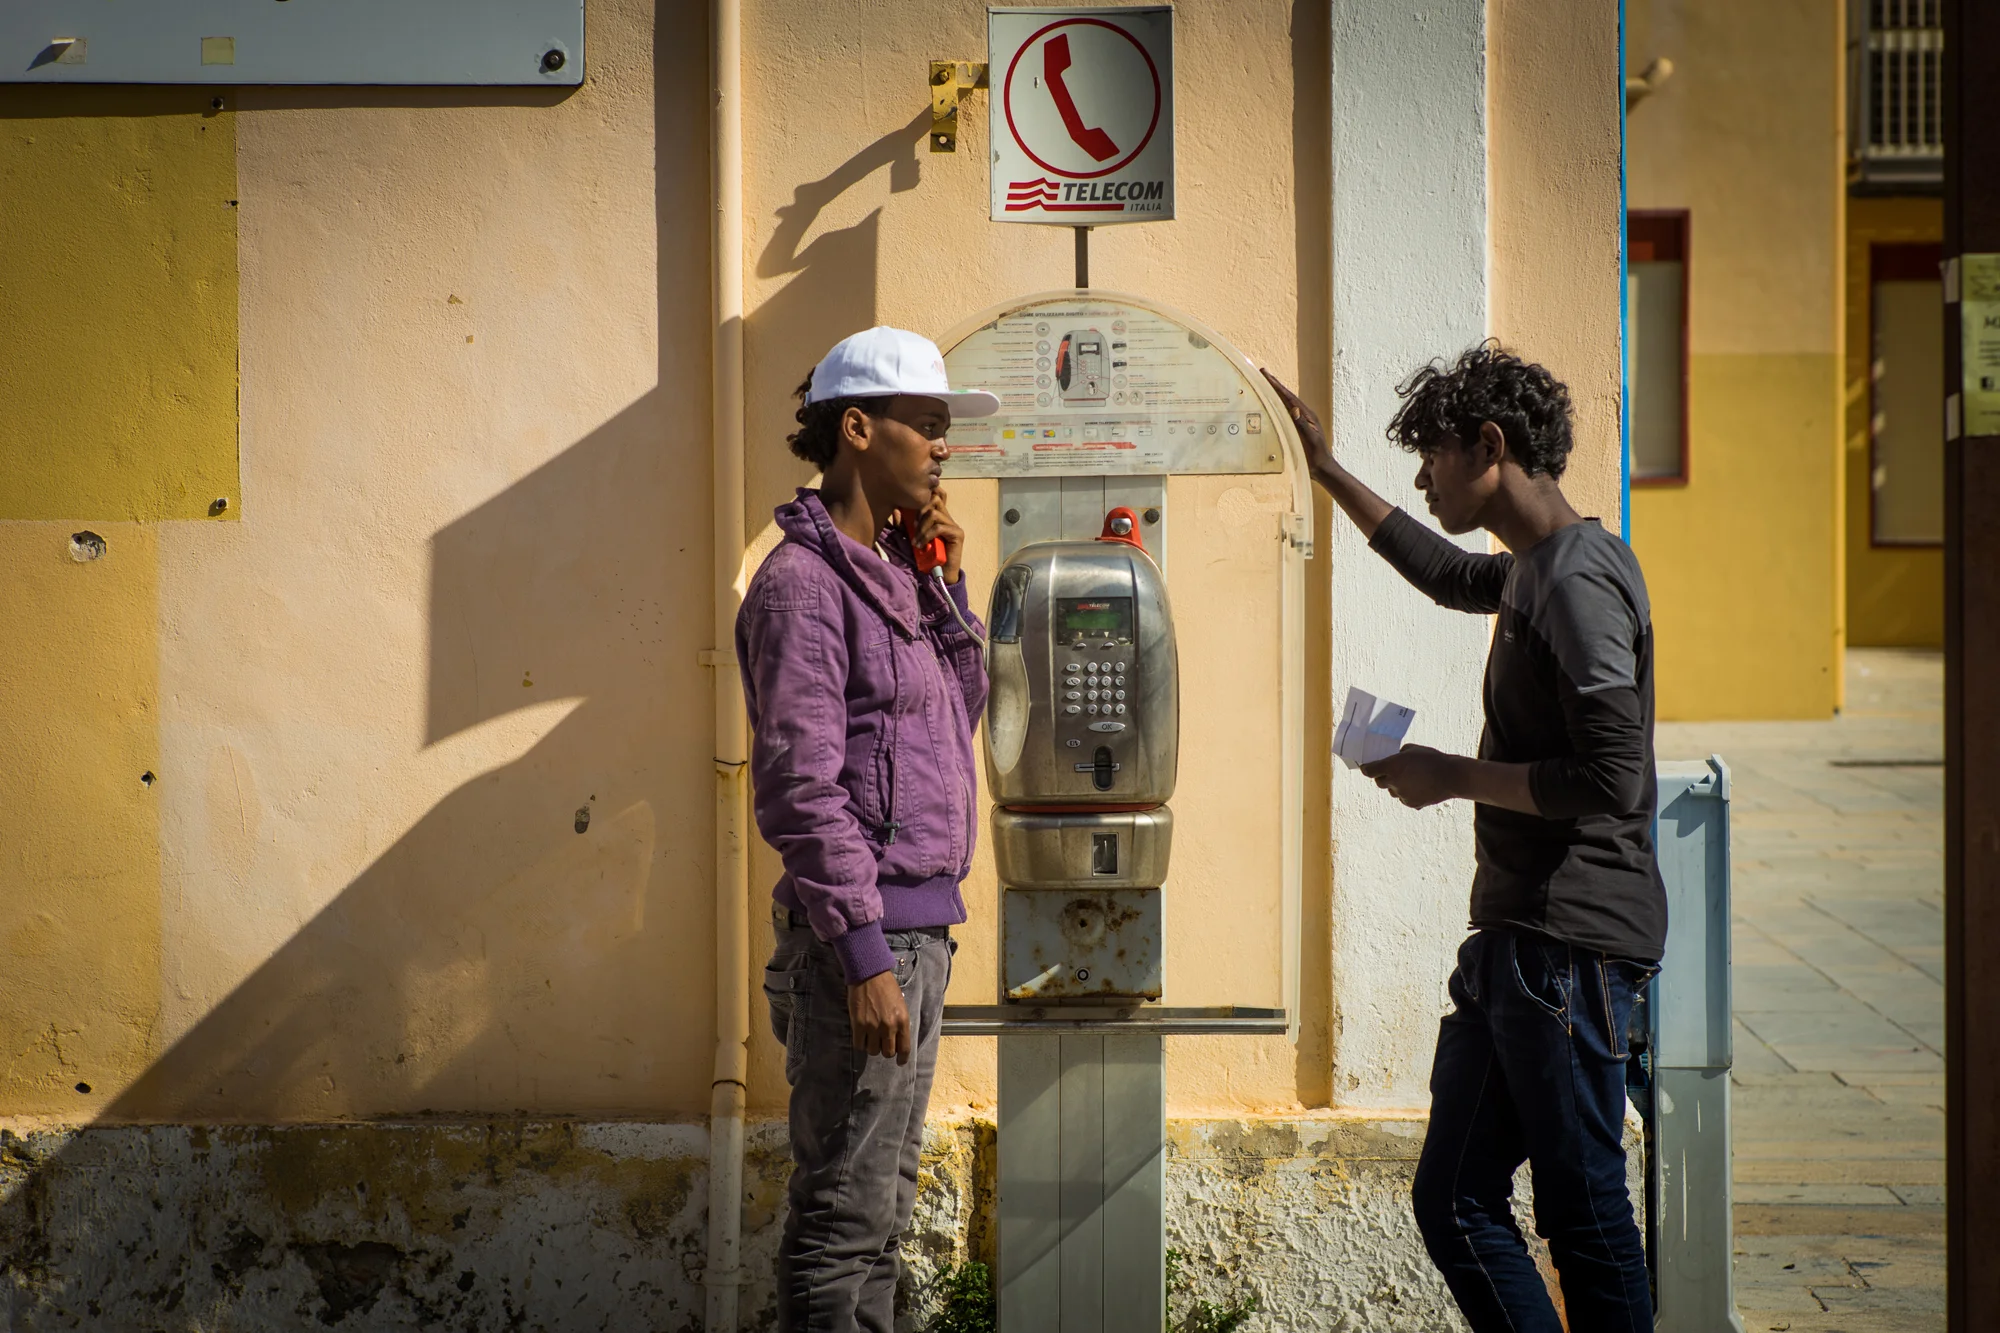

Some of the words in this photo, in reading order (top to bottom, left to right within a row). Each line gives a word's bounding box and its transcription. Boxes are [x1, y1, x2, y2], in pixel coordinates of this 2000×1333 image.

[1063, 181, 1164, 202] TELECOM
[1130, 203, 1162, 211] ITALIA
[1101, 723, 1113, 731] OK
